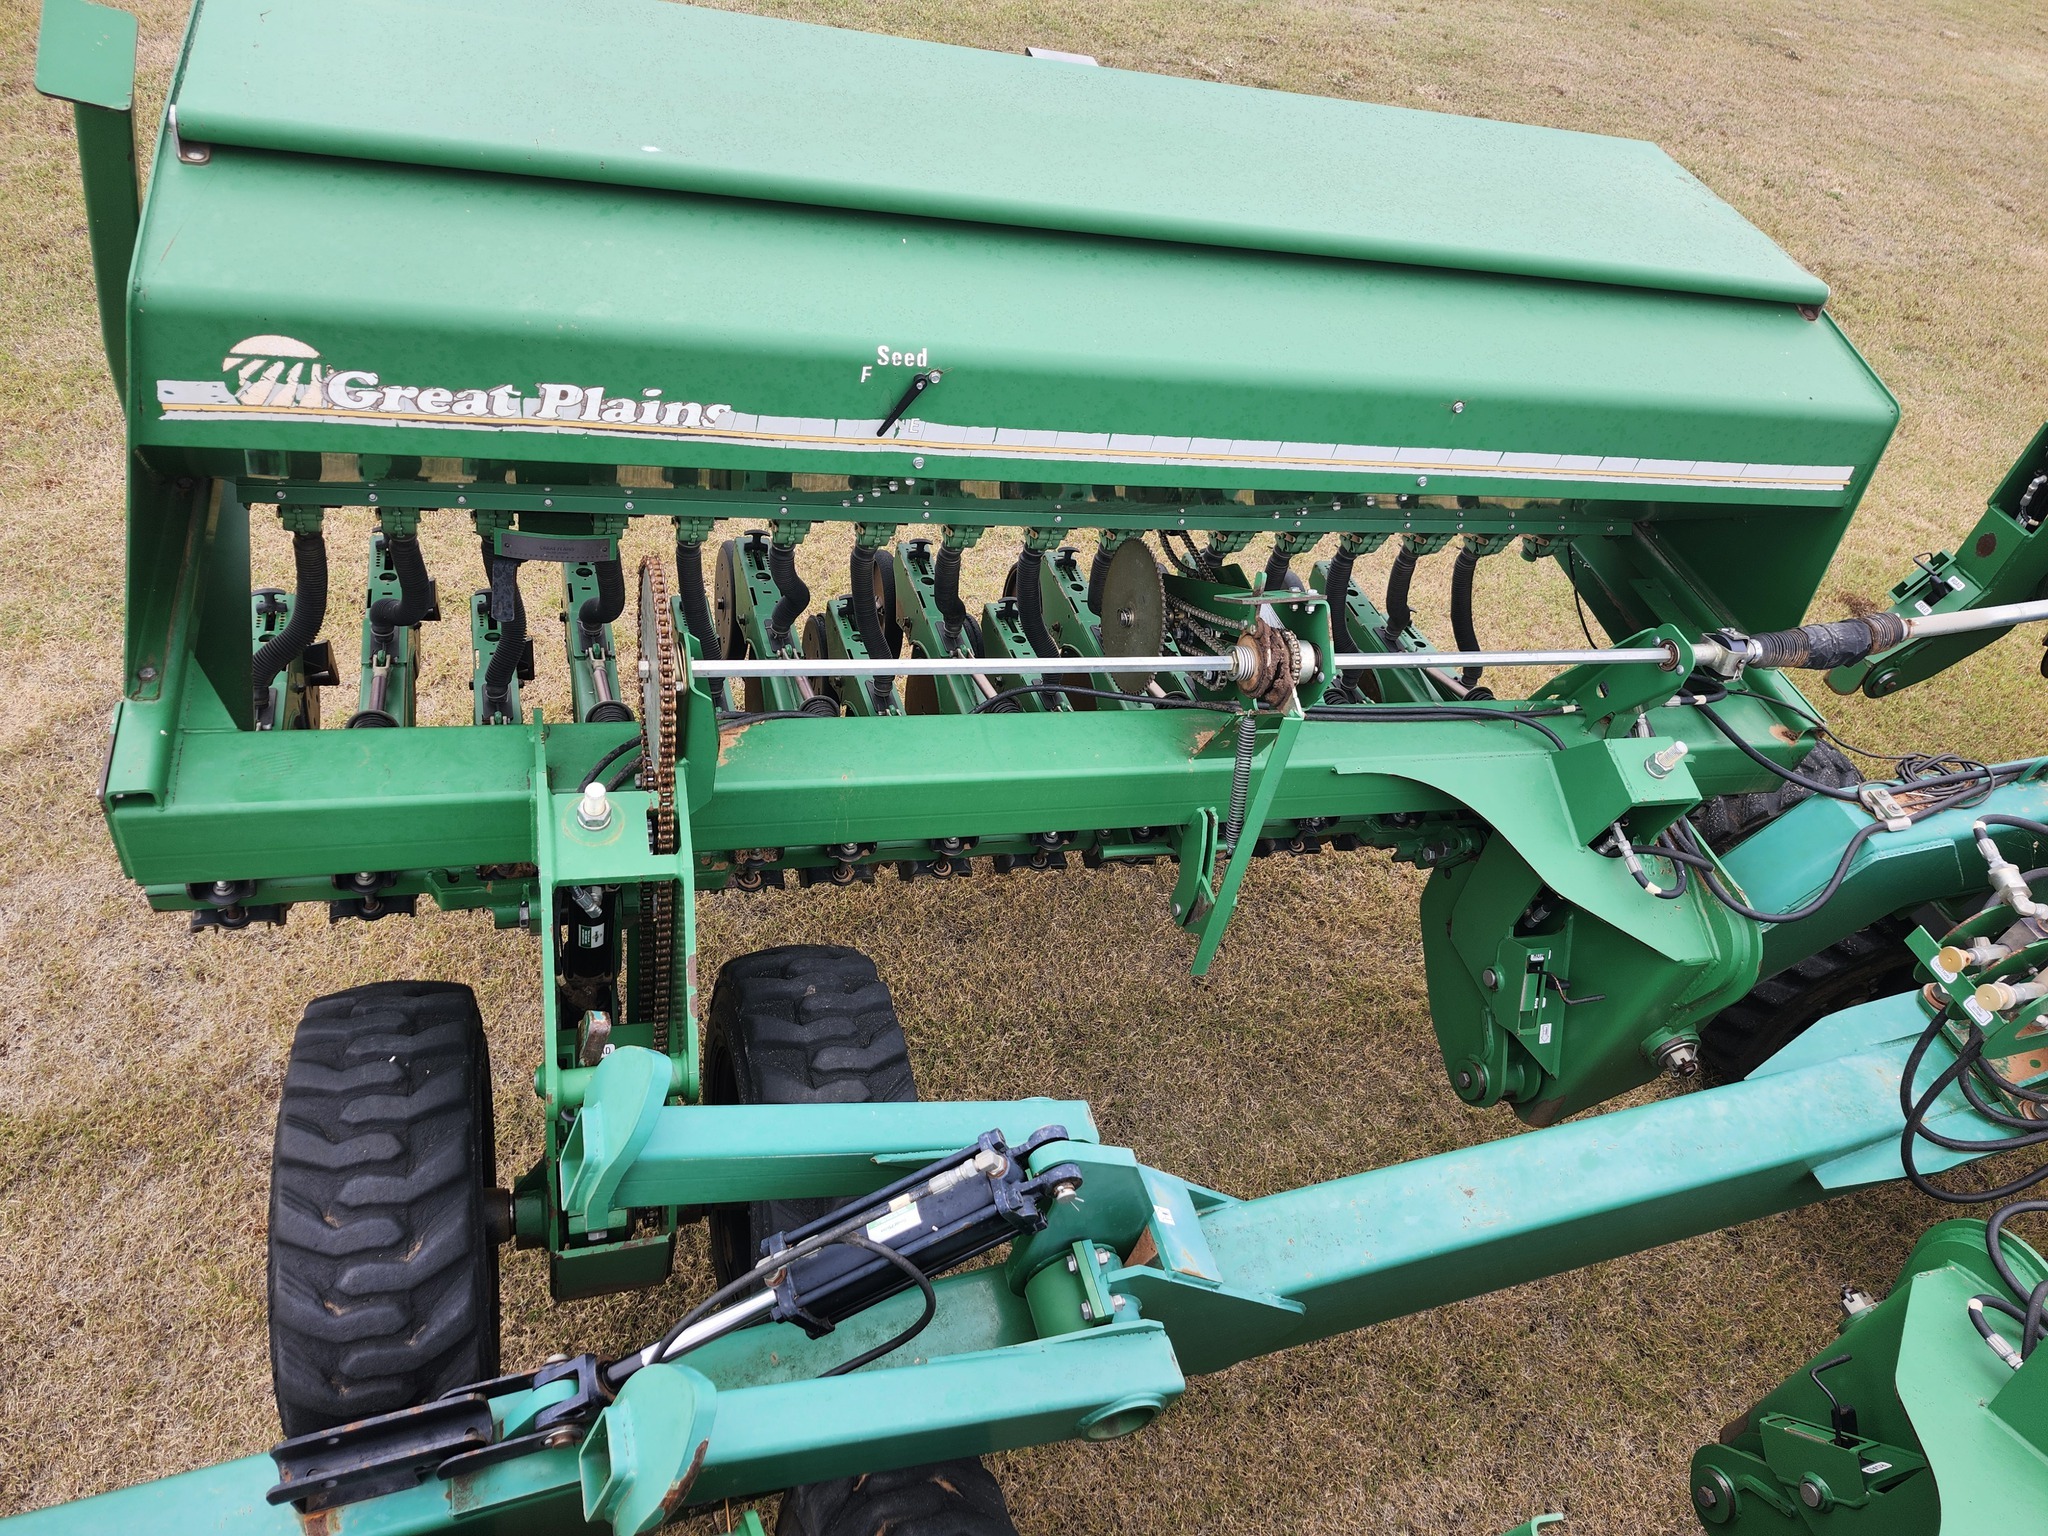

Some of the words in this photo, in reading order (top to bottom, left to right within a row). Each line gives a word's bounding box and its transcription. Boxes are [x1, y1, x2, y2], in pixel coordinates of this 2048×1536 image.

[877, 345, 928, 367] Seed
[860, 366, 873, 383] F
[327, 370, 522, 418] Great
[536, 383, 732, 429] Plains
[909, 418, 920, 433] E
